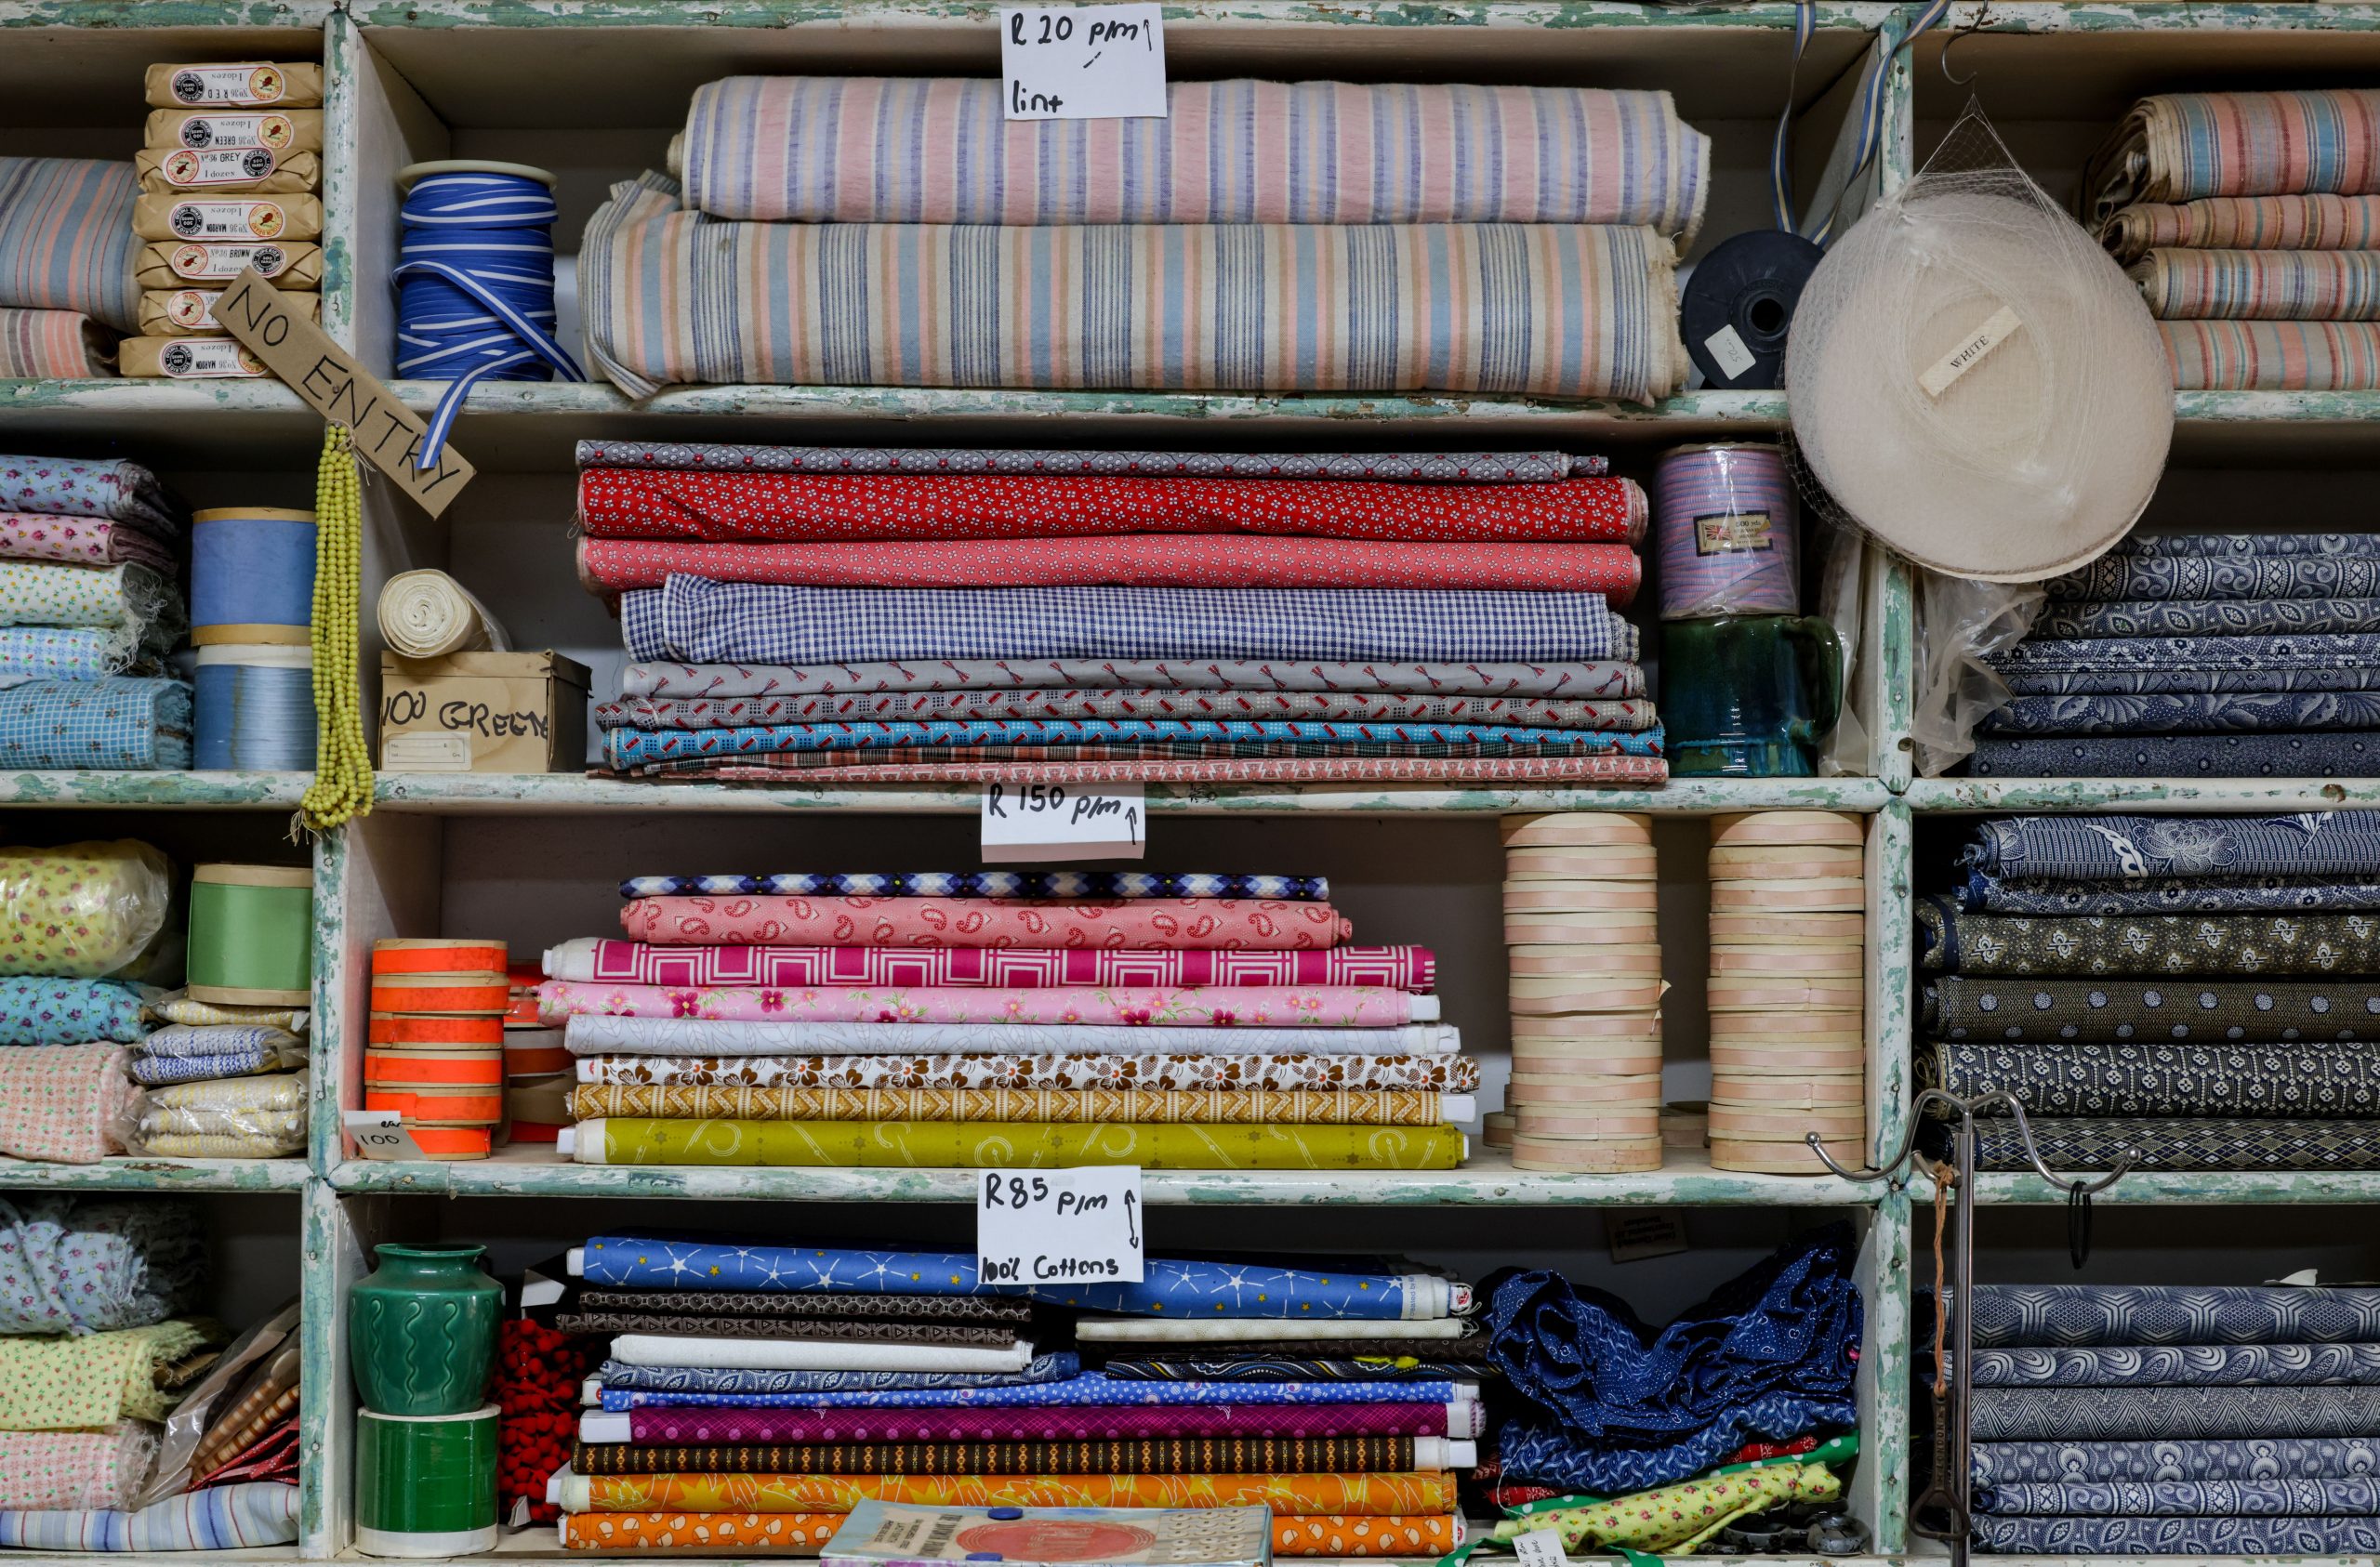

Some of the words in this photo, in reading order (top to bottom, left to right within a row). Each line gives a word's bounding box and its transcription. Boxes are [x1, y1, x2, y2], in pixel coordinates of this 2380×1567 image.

[1038, 15, 1073, 45] 20
[207, 88, 229, 99] RED
[1012, 80, 1064, 113] lint
[215, 136, 236, 145] GREEN
[219, 151, 241, 163] GREY
[205, 223, 227, 233] MAROON
[229, 249, 251, 258] BROWN
[227, 283, 289, 347] NO
[1950, 336, 1990, 368] WHITE
[195, 360, 217, 370] MAROON
[382, 691, 427, 726] 100
[439, 701, 549, 740] GREEN
[1019, 785, 1064, 812] 150
[1071, 796, 1121, 825] p/m
[361, 1135, 400, 1145] 100
[1057, 1192, 1108, 1216] p/m
[1033, 1255, 1119, 1279] Cottons
